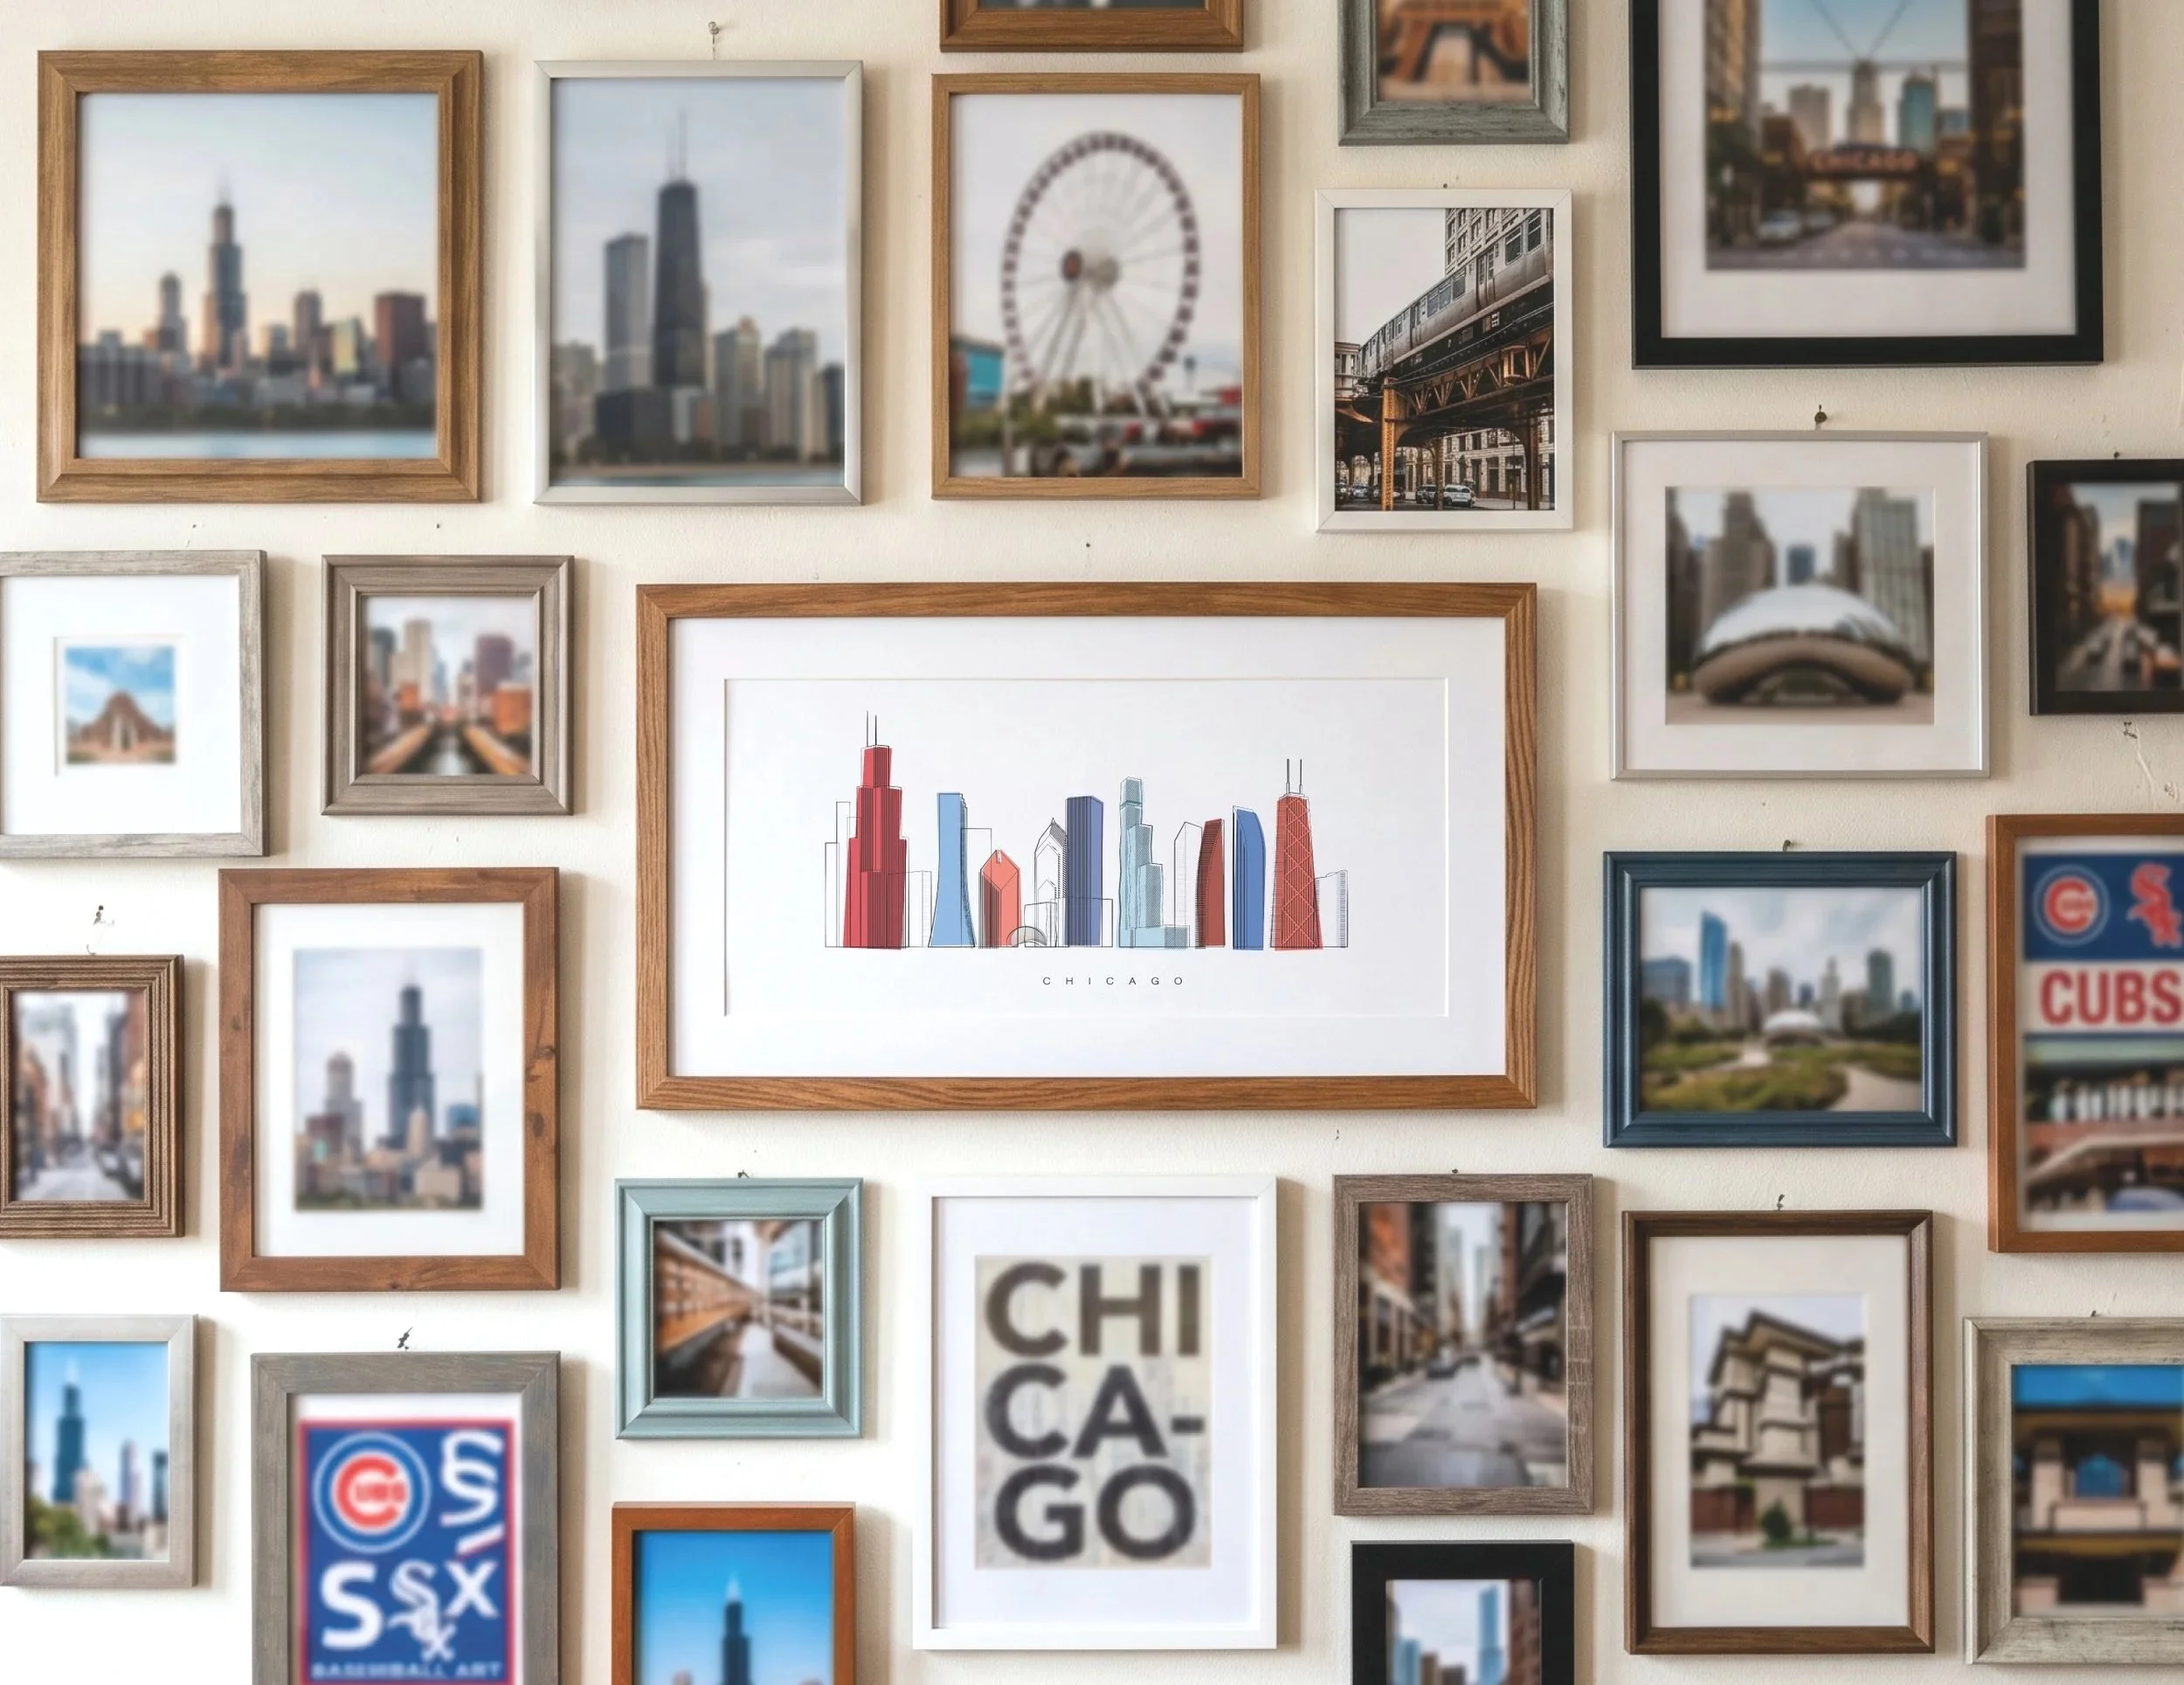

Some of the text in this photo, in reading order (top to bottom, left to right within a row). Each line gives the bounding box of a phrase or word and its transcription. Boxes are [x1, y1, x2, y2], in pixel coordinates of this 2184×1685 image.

[1042, 977, 1183, 985] CHICAGO
[2040, 969, 2183, 1026] CUBS
[985, 1261, 1201, 1358] CHI
[984, 1363, 1205, 1461] CA-
[993, 1464, 1197, 1563] GO
